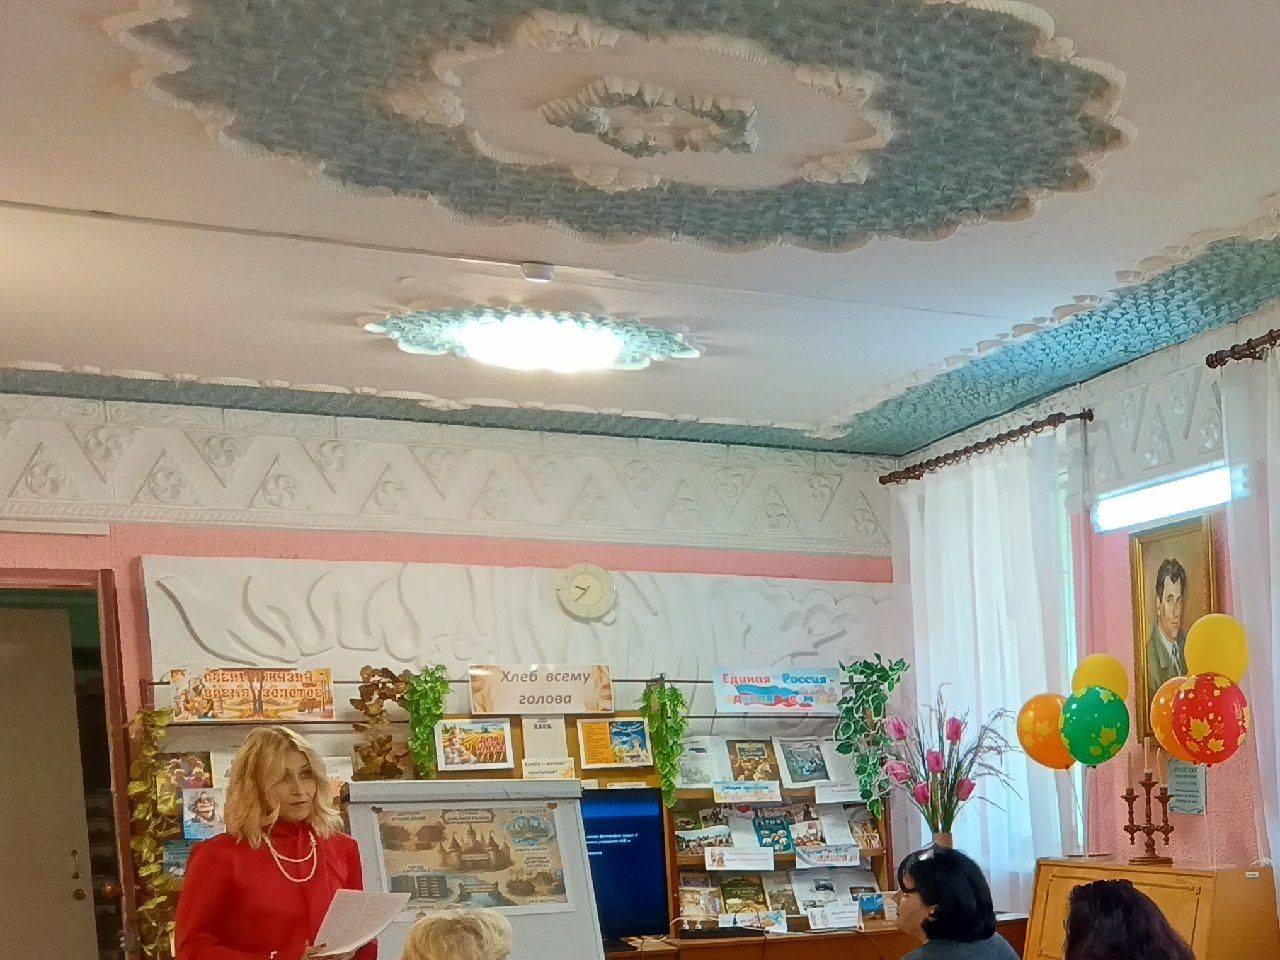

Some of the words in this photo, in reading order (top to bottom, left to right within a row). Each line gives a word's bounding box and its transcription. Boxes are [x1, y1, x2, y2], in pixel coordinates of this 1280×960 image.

[500, 670, 538, 682] Хлеб
[545, 671, 591, 684] всему
[722, 673, 771, 685] Единая
[781, 673, 827, 684] Россия
[519, 694, 572, 705] голова
